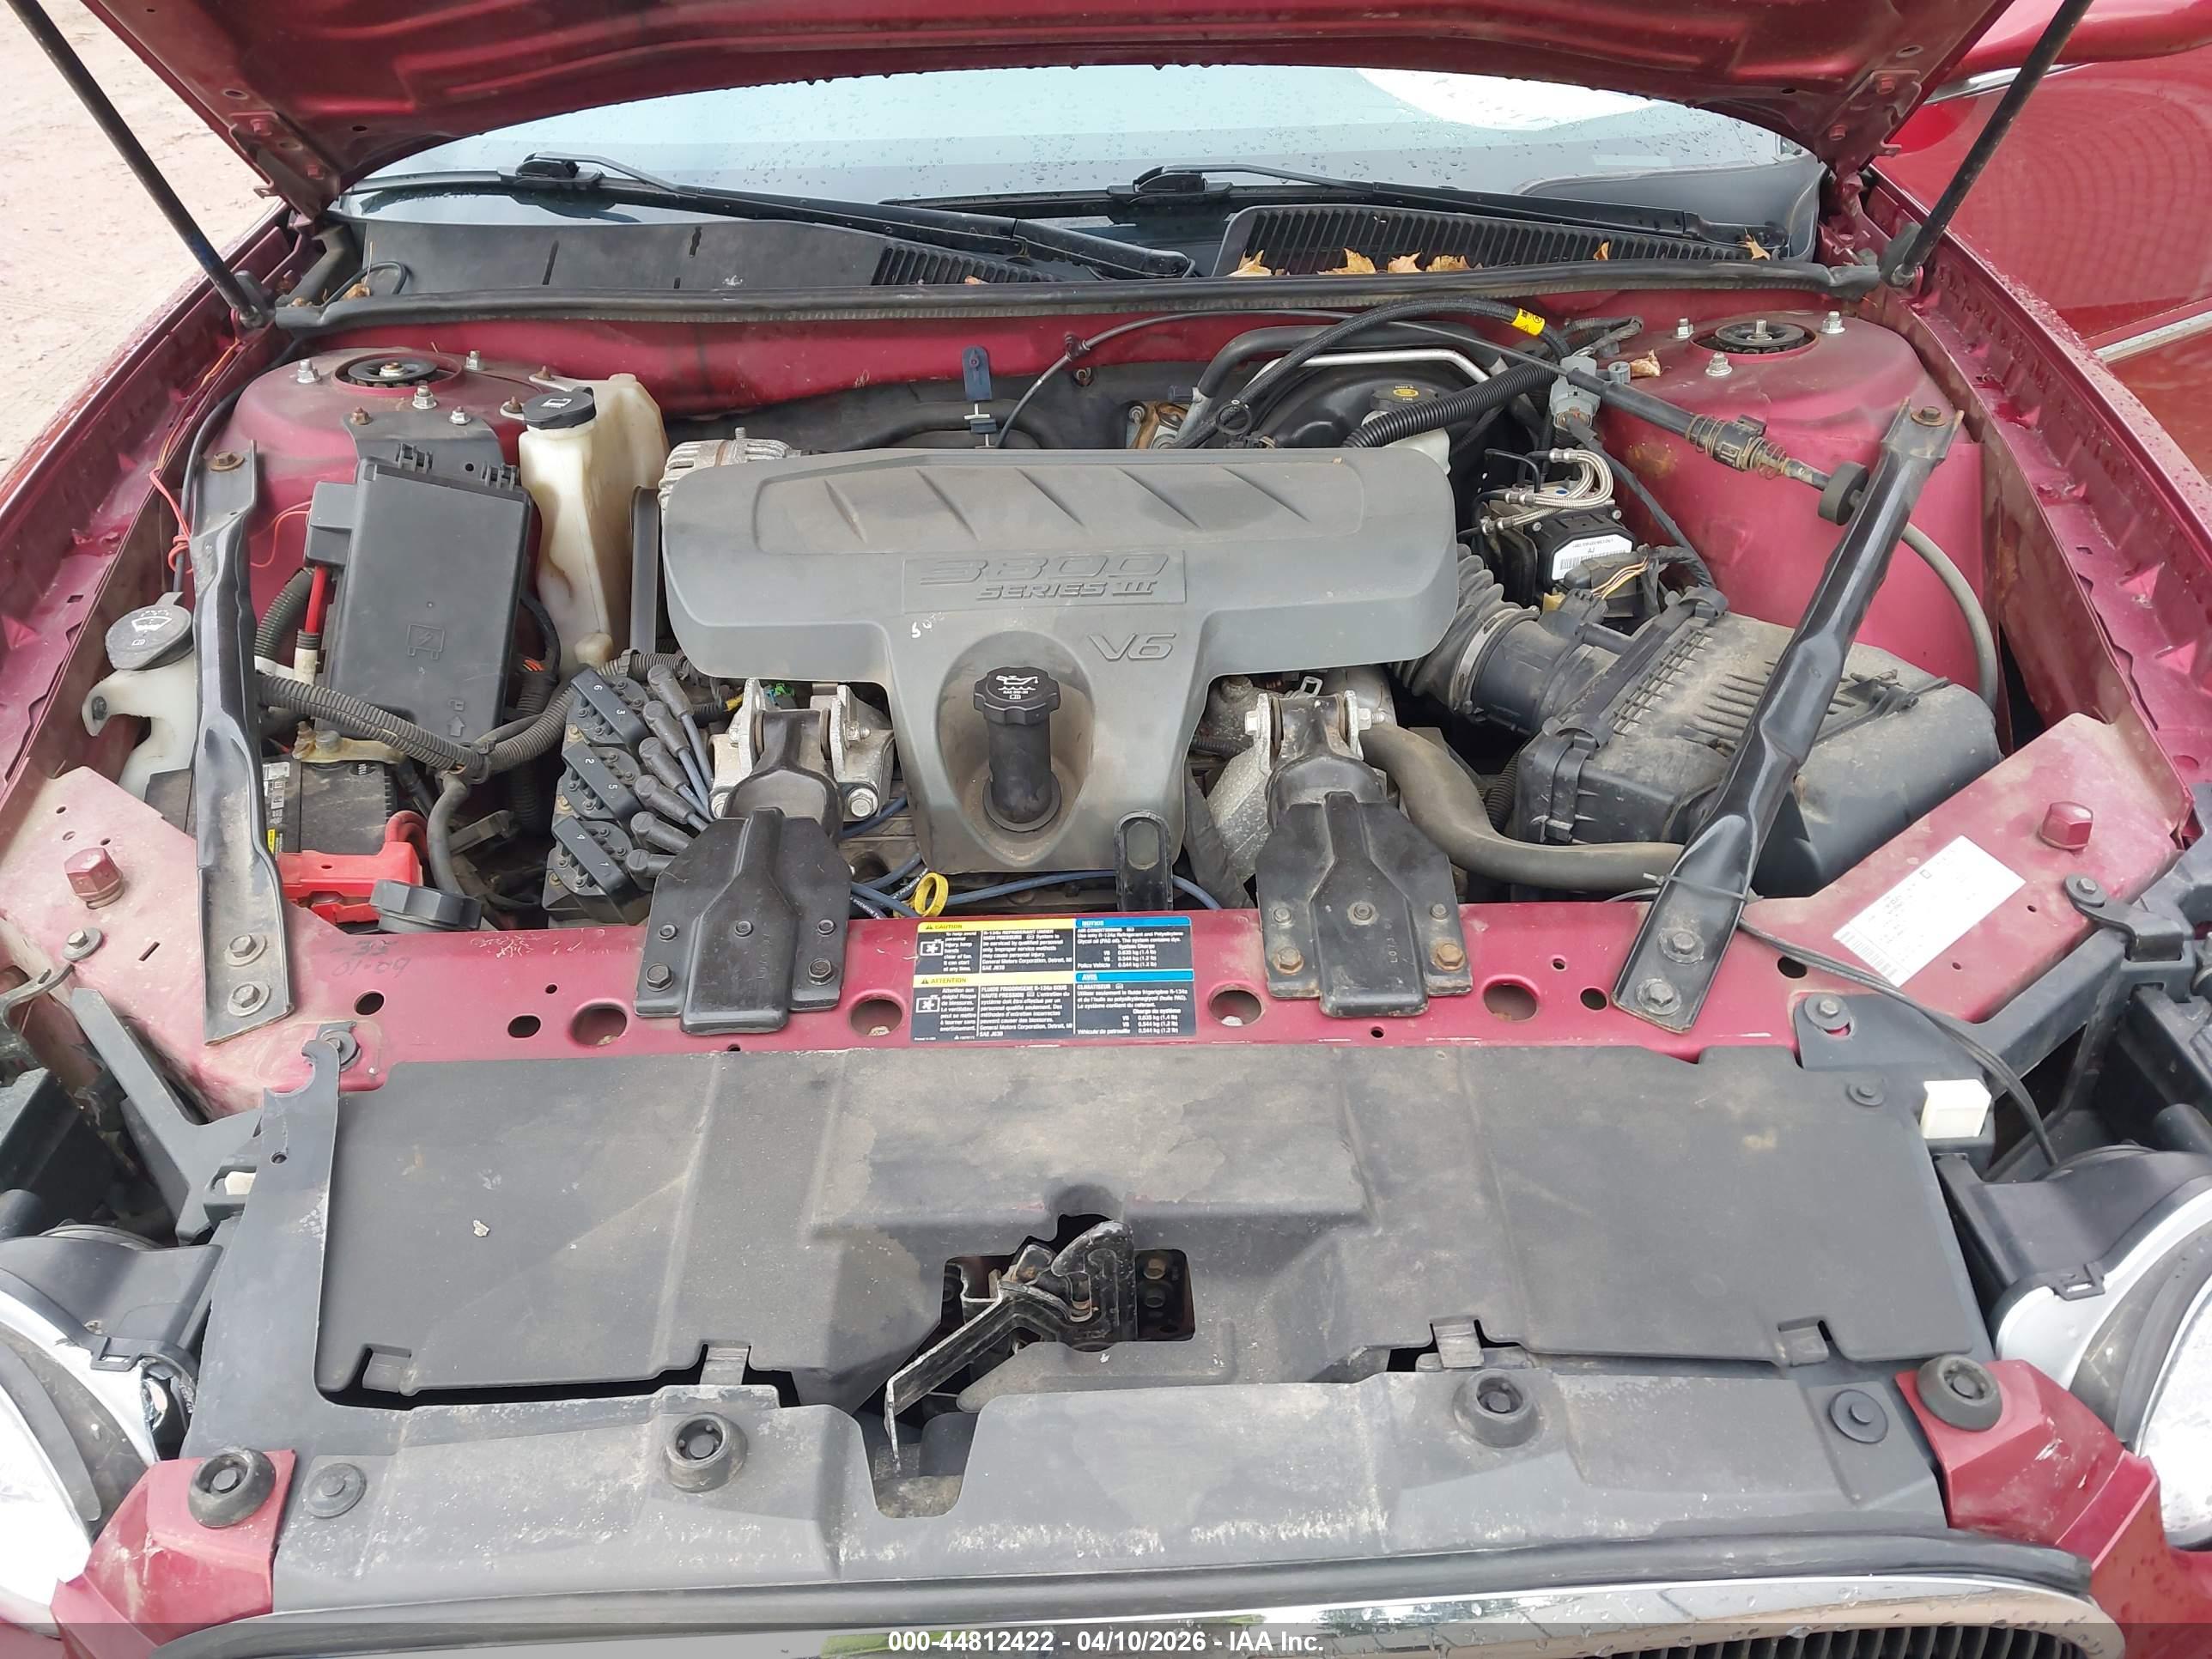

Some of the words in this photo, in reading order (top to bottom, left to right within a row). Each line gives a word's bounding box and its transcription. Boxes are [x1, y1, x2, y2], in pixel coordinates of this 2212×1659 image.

[921, 554, 1169, 585] 3800
[975, 582, 1108, 601] SERIES
[1112, 580, 1158, 598] III
[1088, 632, 1176, 662] V6
